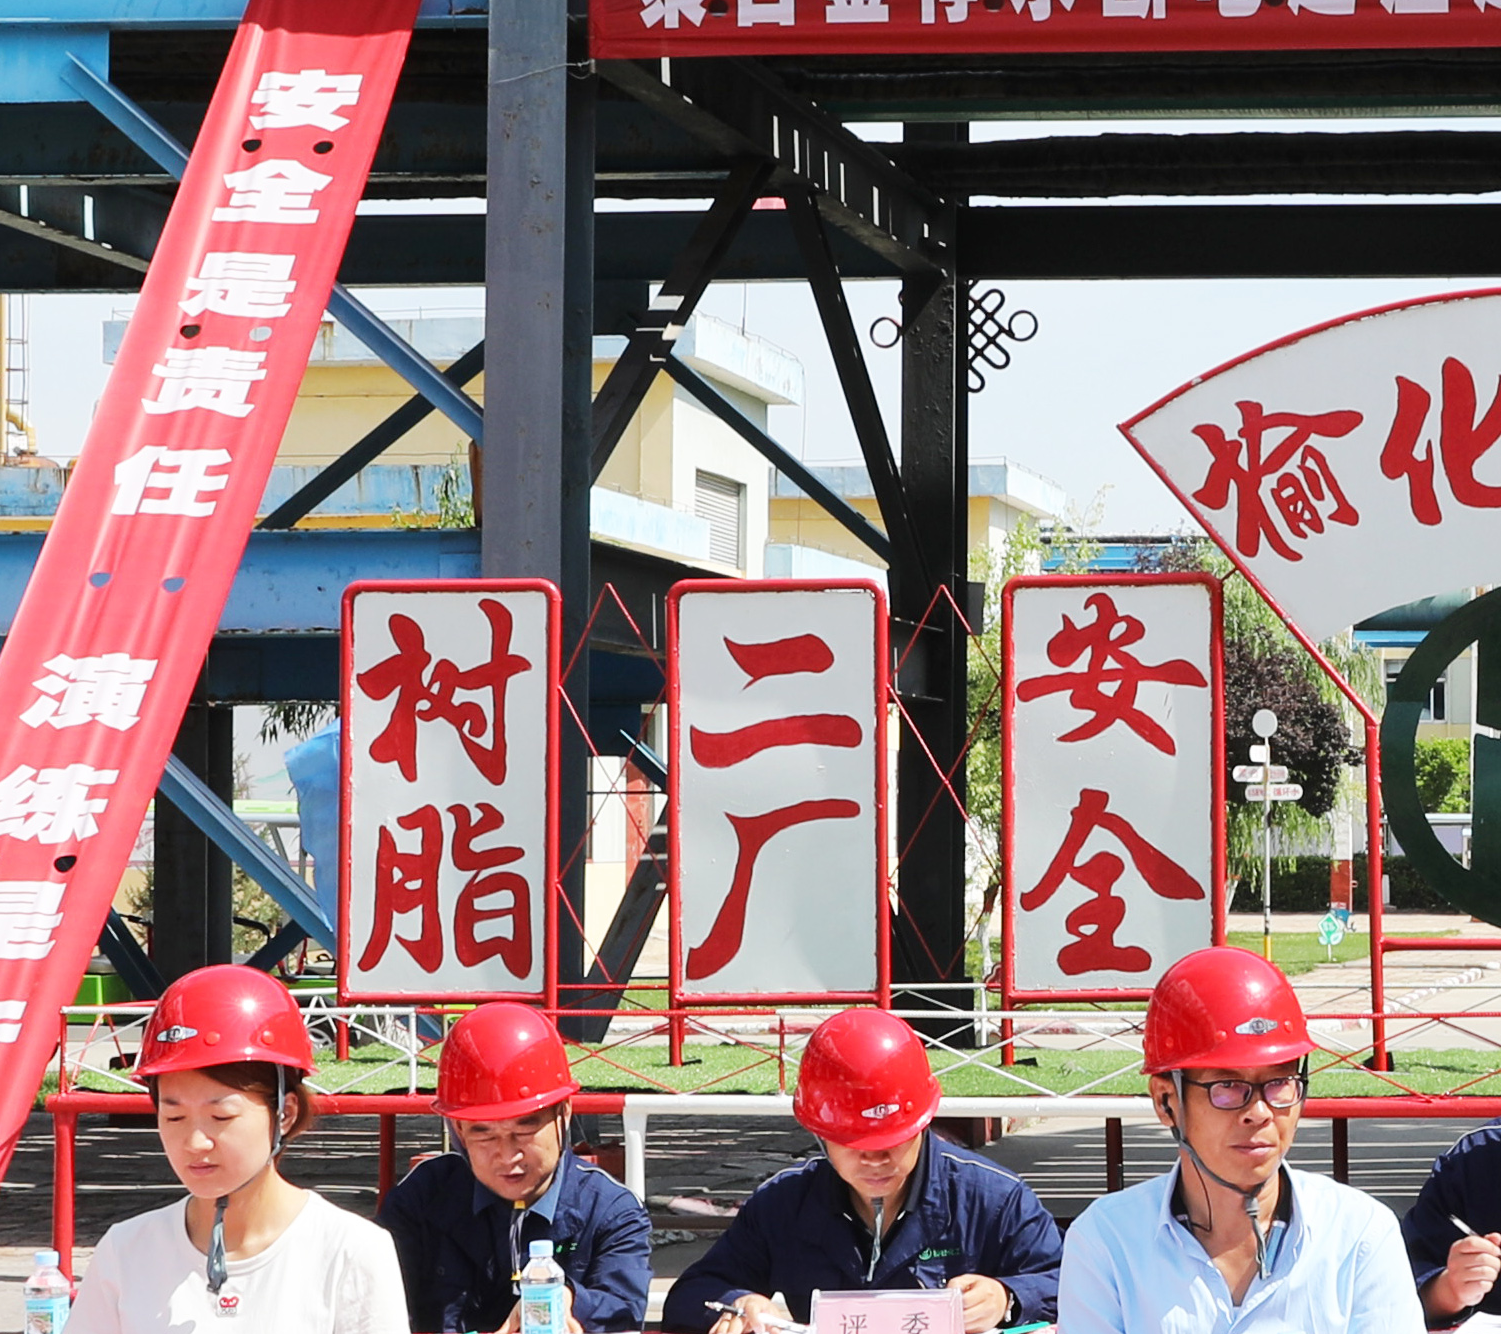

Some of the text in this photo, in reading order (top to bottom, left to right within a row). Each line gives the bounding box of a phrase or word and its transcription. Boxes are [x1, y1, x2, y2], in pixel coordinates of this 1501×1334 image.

[110, 68, 363, 518] 安全是责任
[356, 598, 532, 980] 树脂
[687, 633, 862, 981] 二厂
[1016, 593, 1208, 977] 安全
